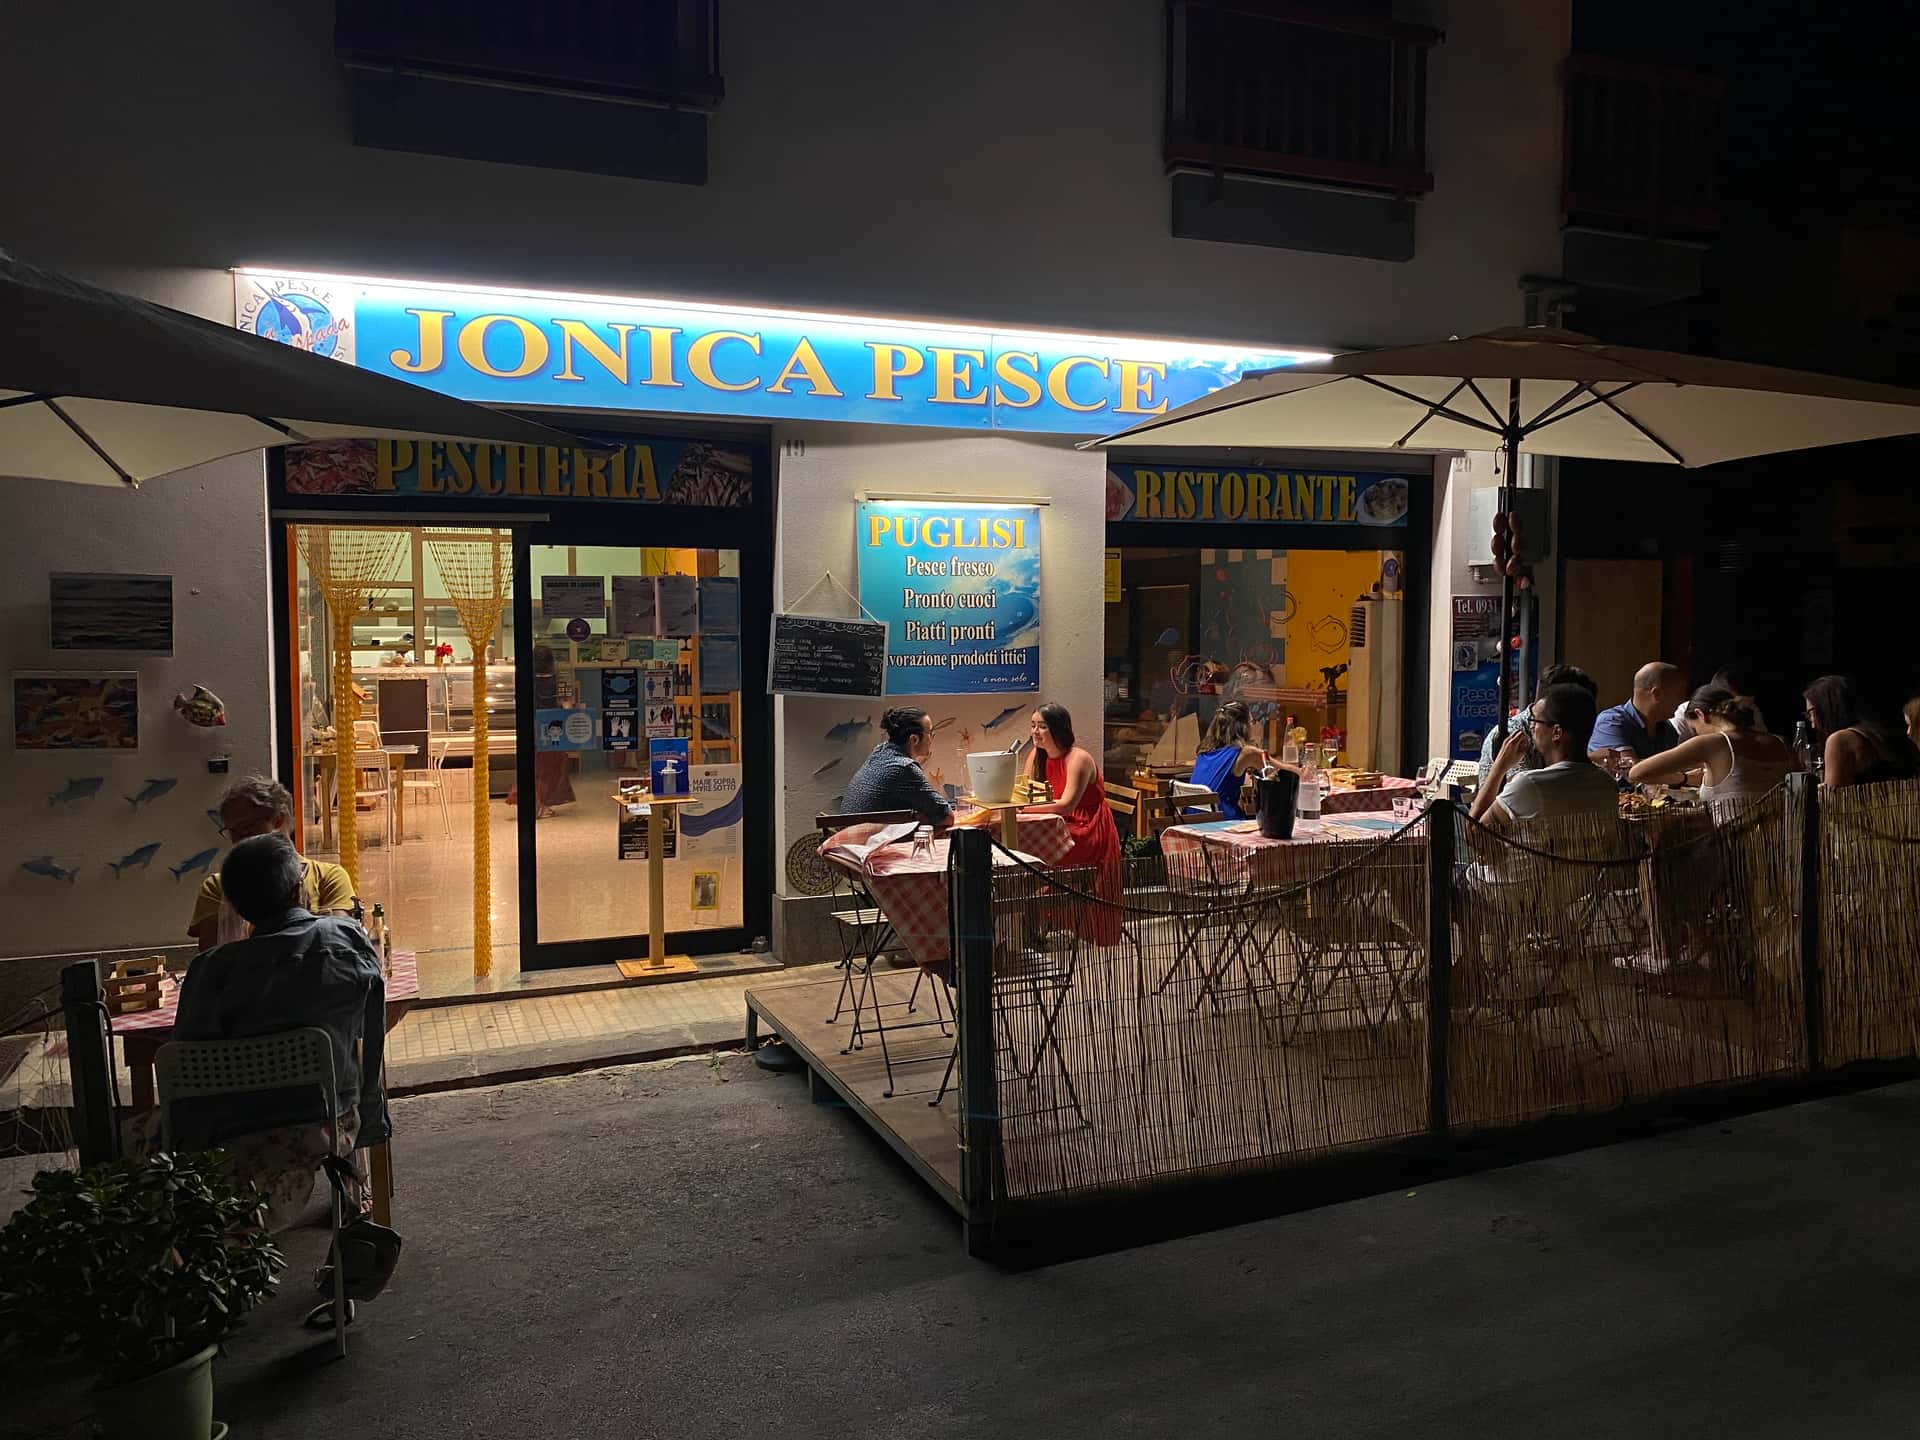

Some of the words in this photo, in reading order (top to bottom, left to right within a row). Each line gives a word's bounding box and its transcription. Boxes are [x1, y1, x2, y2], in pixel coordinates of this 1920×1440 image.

[239, 293, 264, 330] NICA
[274, 280, 333, 304] PESCE
[390, 309, 844, 397] JONICA
[864, 342, 1169, 414] PESCE
[375, 439, 661, 499] PESCHERIA
[1134, 470, 1357, 522] RISTORANTE
[868, 515, 1026, 549] PUGLISI
[906, 556, 946, 577] Pesce
[950, 556, 994, 577] fresco
[903, 588, 954, 609] Pronto
[958, 589, 997, 608] cuoci
[1456, 600, 1473, 614] Tel.
[906, 621, 946, 641] Piatti
[950, 621, 995, 645] pronti
[886, 651, 947, 667] vorazione
[950, 650, 998, 670] prodotti
[1000, 649, 1026, 666] ittici
[1459, 687, 1499, 701] Pesc
[1458, 702, 1498, 717] fresc
[713, 777, 736, 785] SOPRA
